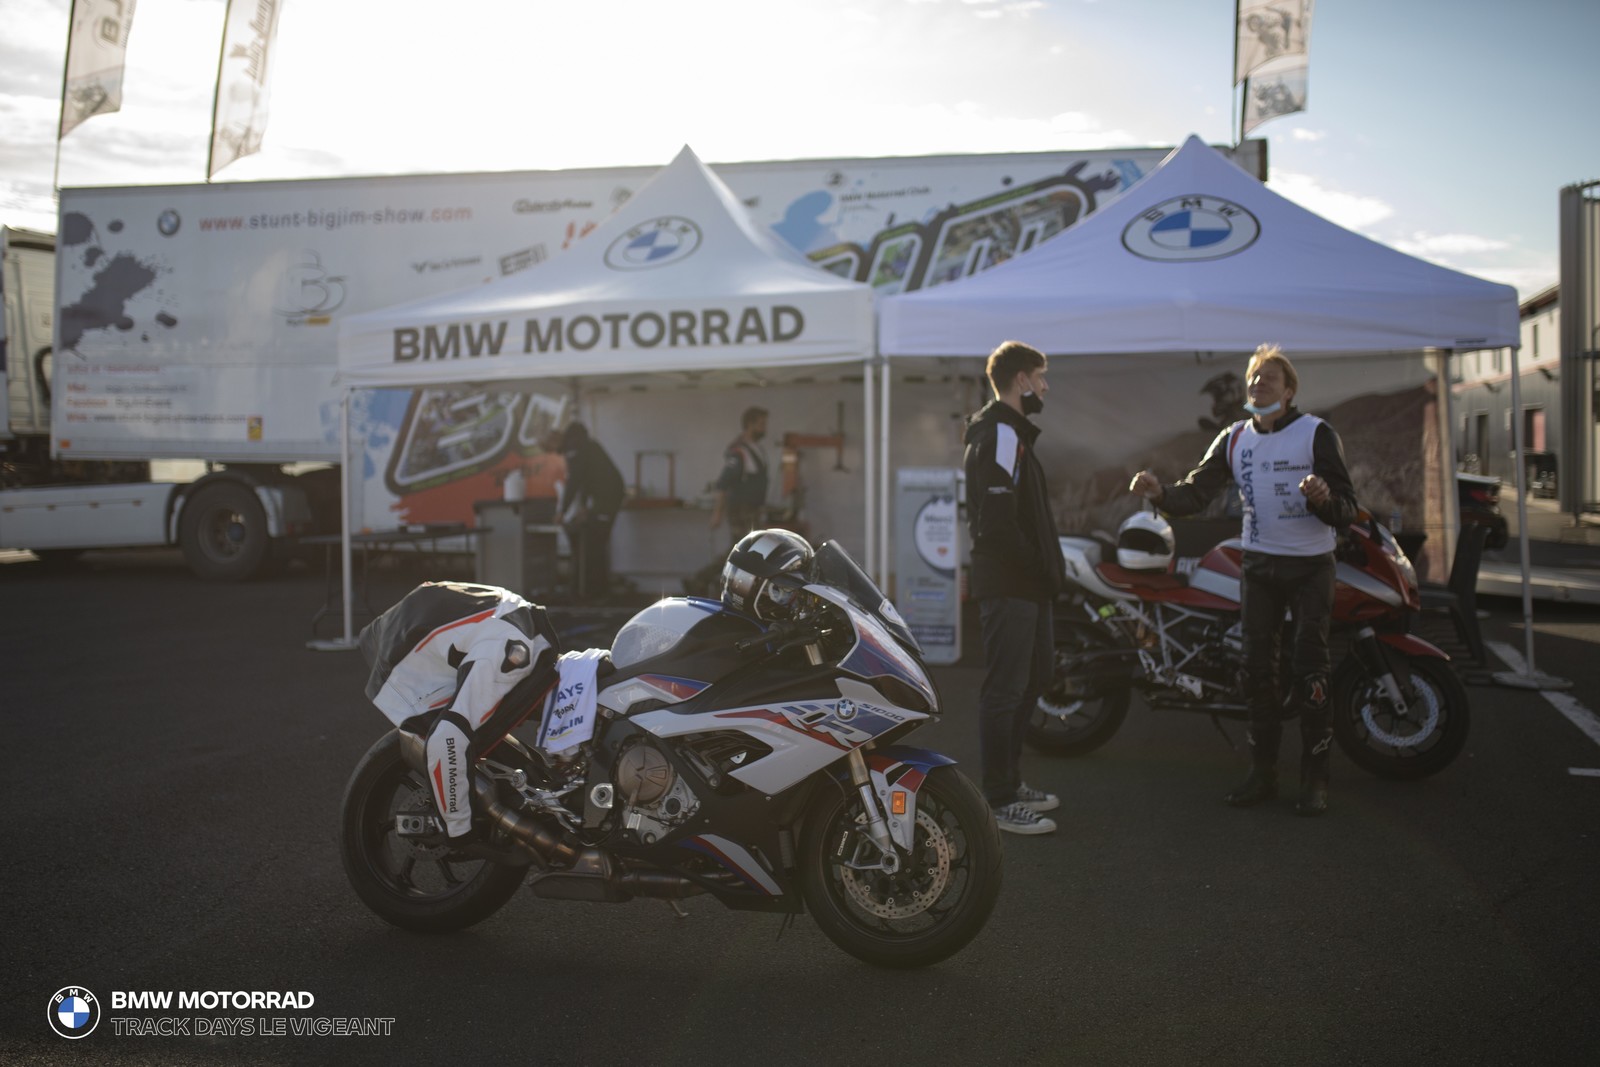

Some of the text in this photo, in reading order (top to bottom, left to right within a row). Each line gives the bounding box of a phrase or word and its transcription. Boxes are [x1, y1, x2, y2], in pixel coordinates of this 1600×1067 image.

[199, 206, 472, 231] www.stunt-bigjim-show.com
[1142, 197, 1242, 222] BMW
[393, 305, 806, 363] BMW MOTORRAD
[859, 703, 905, 722] S1000
[445, 737, 458, 766] BMW
[448, 767, 459, 814] Motorrad
